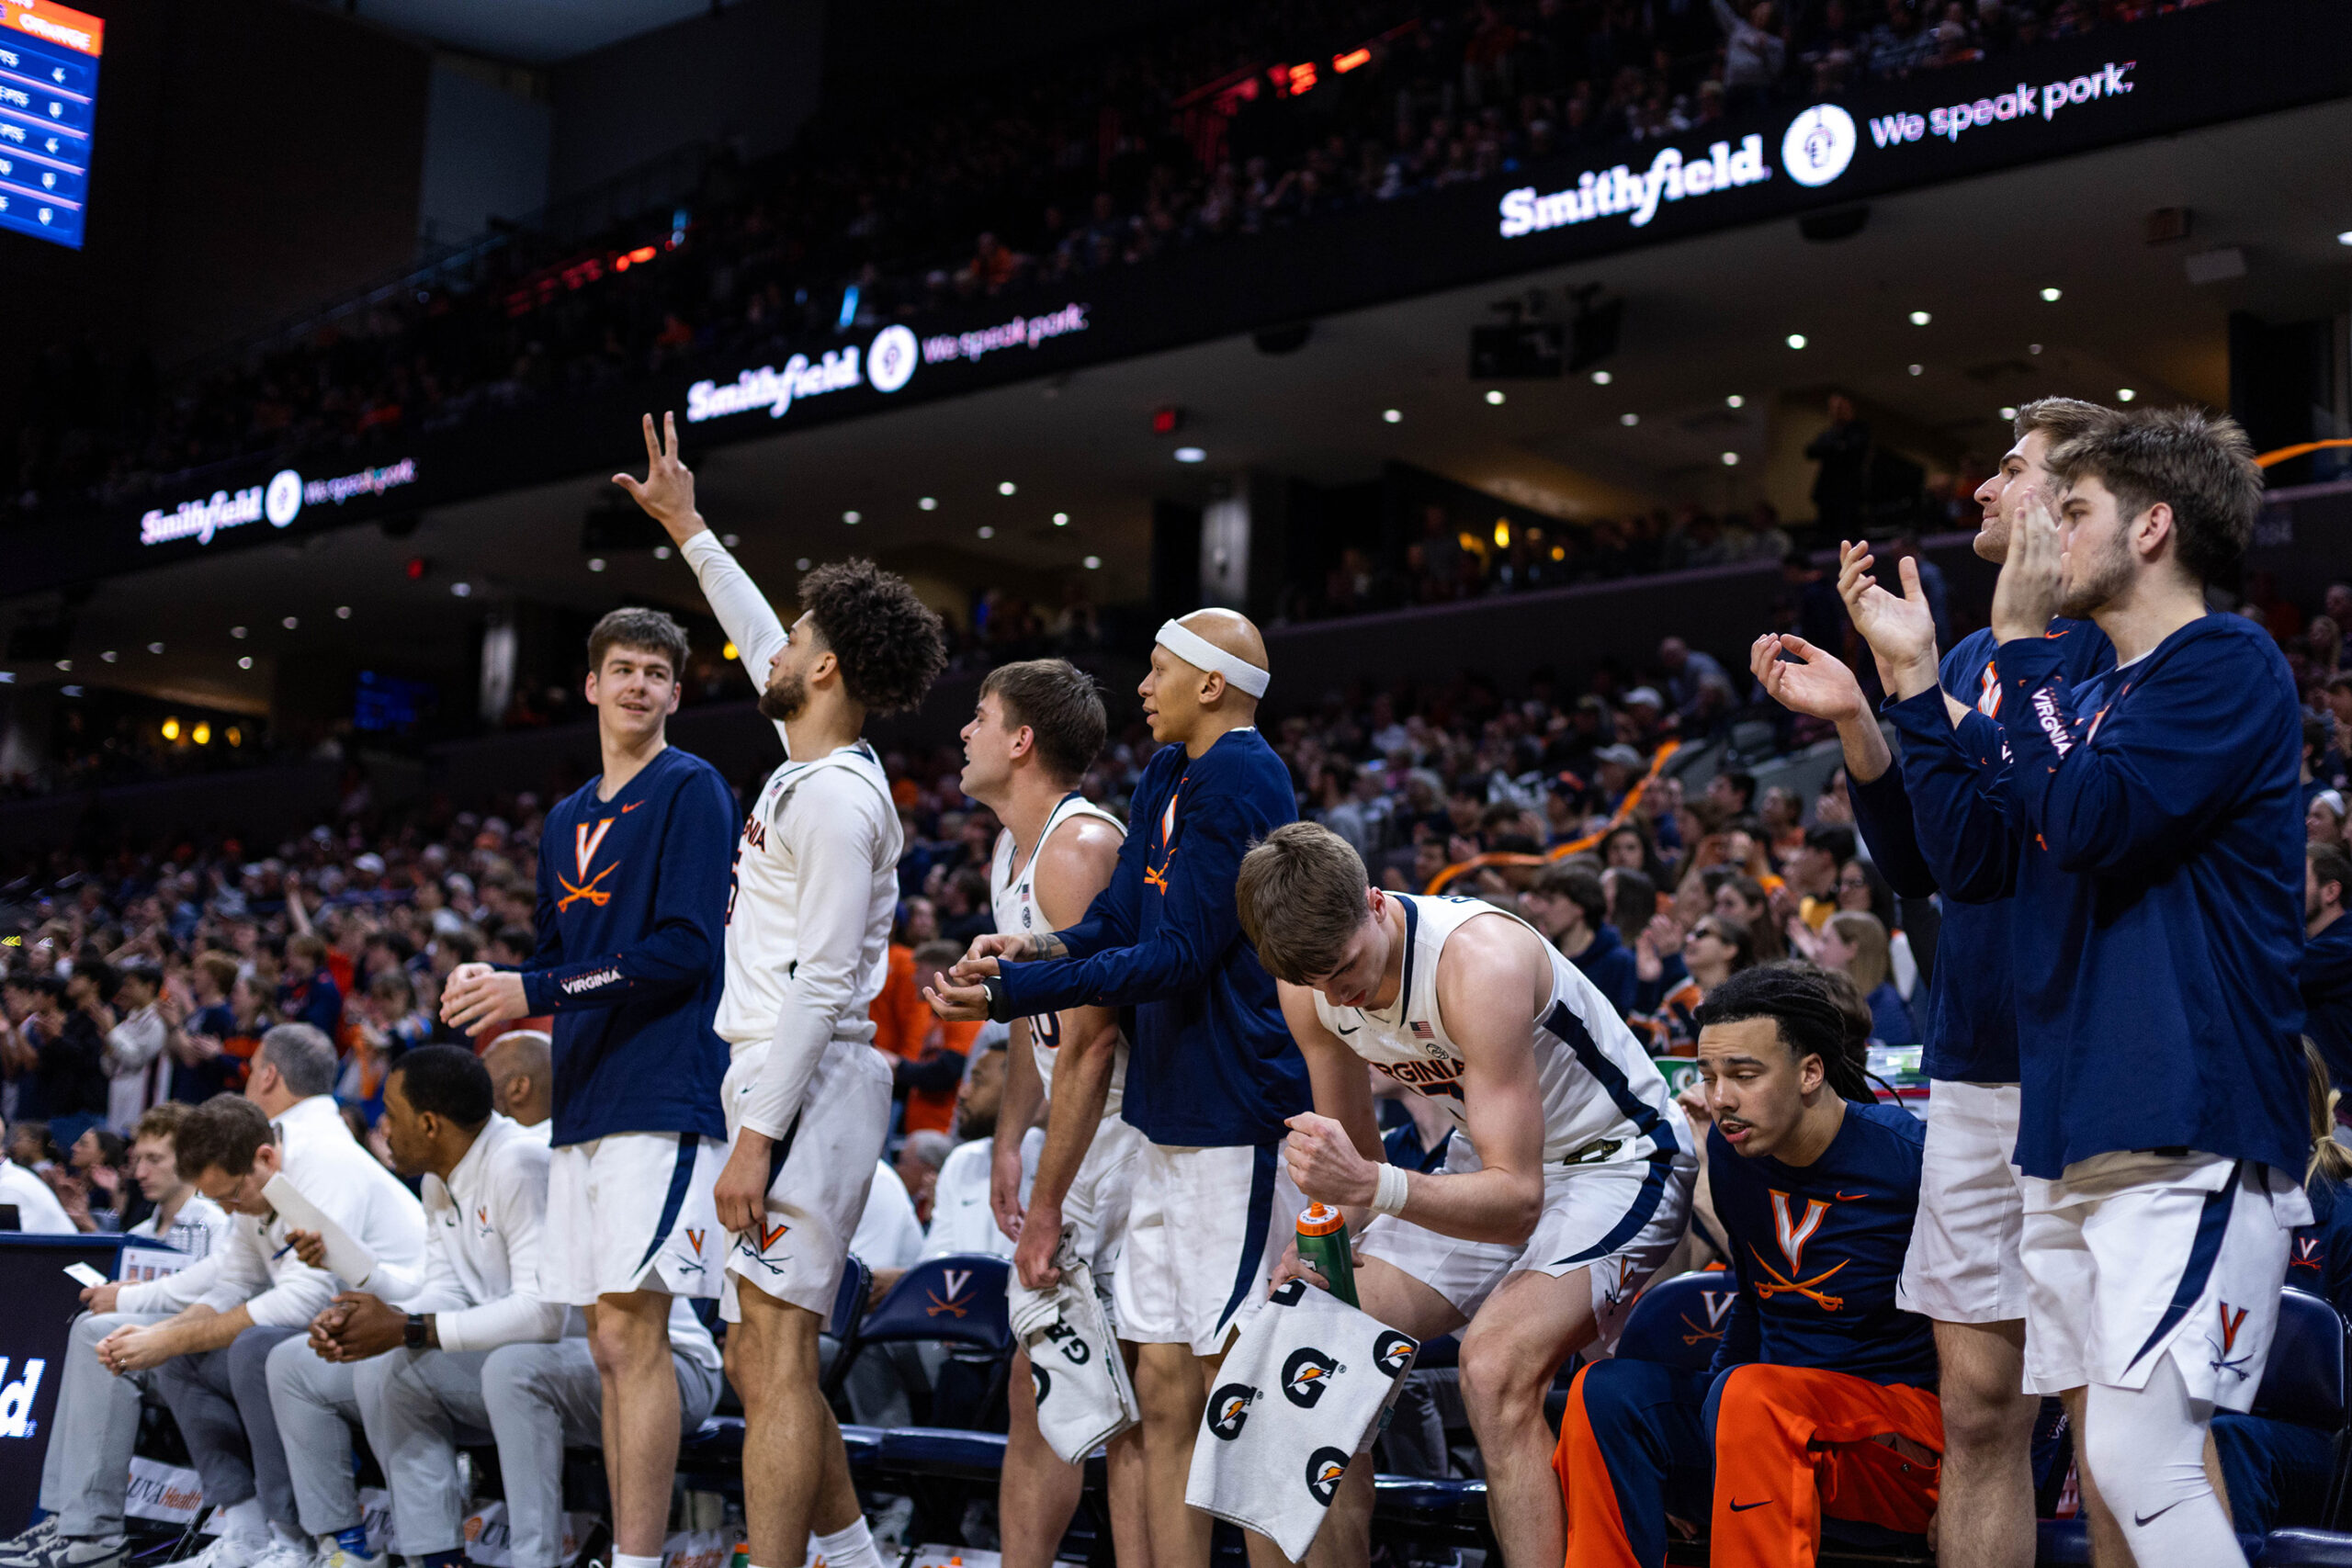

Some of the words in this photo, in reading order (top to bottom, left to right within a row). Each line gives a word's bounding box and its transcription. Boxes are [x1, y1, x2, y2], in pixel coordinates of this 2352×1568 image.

[1870, 112, 1926, 148] We
[1929, 83, 2039, 142] speak
[1500, 134, 1766, 240] Smithfield
[922, 334, 958, 365] We
[959, 315, 1027, 363] speak
[686, 344, 861, 423] Smithfield
[140, 485, 264, 546] Smithfield
[2031, 687, 2074, 757] VIRGINIA
[561, 969, 622, 995] VIRGINIA
